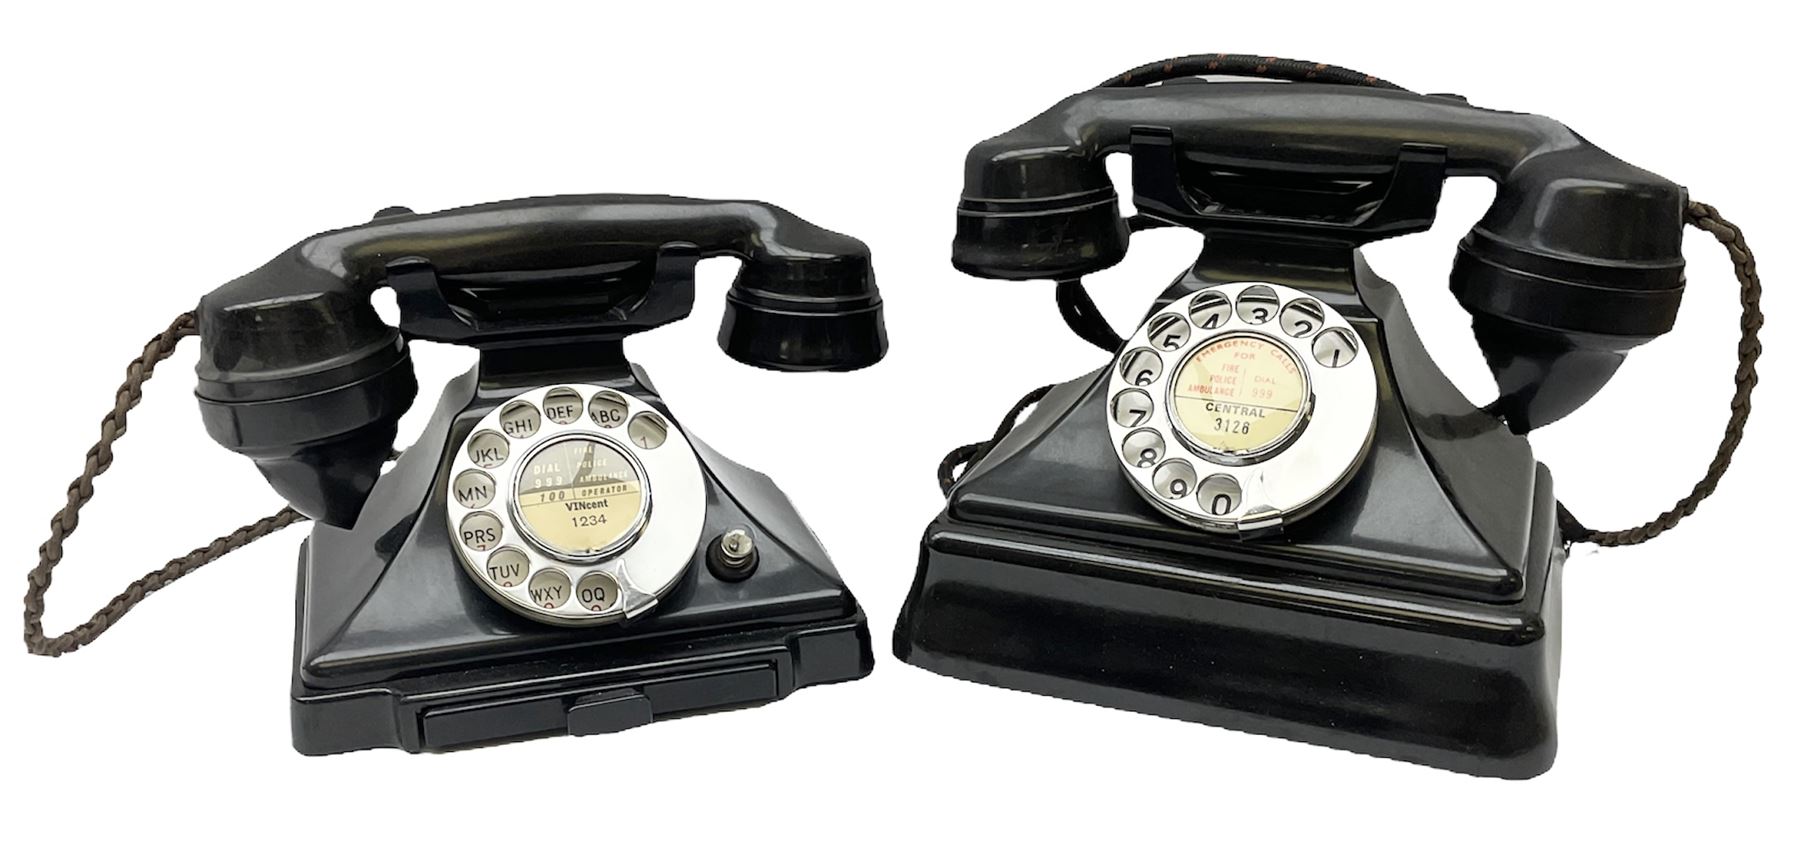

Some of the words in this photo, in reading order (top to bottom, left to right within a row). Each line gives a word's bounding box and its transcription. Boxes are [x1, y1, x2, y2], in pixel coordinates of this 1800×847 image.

[1202, 314, 1219, 329] 4
[1252, 308, 1269, 324] 3
[1294, 320, 1313, 337] 2
[1163, 335, 1180, 350] 5
[1195, 340, 1264, 363] EMERGENCY
[1270, 349, 1297, 375] CALLS
[1234, 352, 1256, 360] FOR
[1222, 363, 1240, 374] FIRE
[1135, 370, 1153, 386] 6
[1210, 375, 1237, 385] POLICE
[1254, 376, 1277, 385] DIAL
[1187, 384, 1234, 397] AMBULANCE
[1252, 389, 1273, 399] 999
[546, 405, 575, 419] DEF
[590, 408, 621, 423] ABC
[1205, 402, 1266, 418] CENTRAL
[504, 418, 533, 434] GHI
[1128, 410, 1147, 427] 7
[1214, 417, 1250, 434] 3126
[474, 449, 504, 464] JKL
[574, 446, 593, 454] FIRE
[576, 459, 607, 468] POLICE
[1137, 449, 1157, 467] 8
[533, 463, 560, 475] DIAL
[579, 470, 628, 483] AMBULANCE
[535, 476, 563, 489] 999
[1170, 479, 1187, 498] 9
[458, 486, 487, 503] MN
[540, 491, 565, 503] 100
[581, 484, 628, 497] OPERATOR
[565, 499, 609, 512] VINcent
[572, 514, 607, 528] 1234
[464, 528, 496, 545] PRS
[489, 564, 521, 581] TUV
[531, 587, 563, 602] WXY
